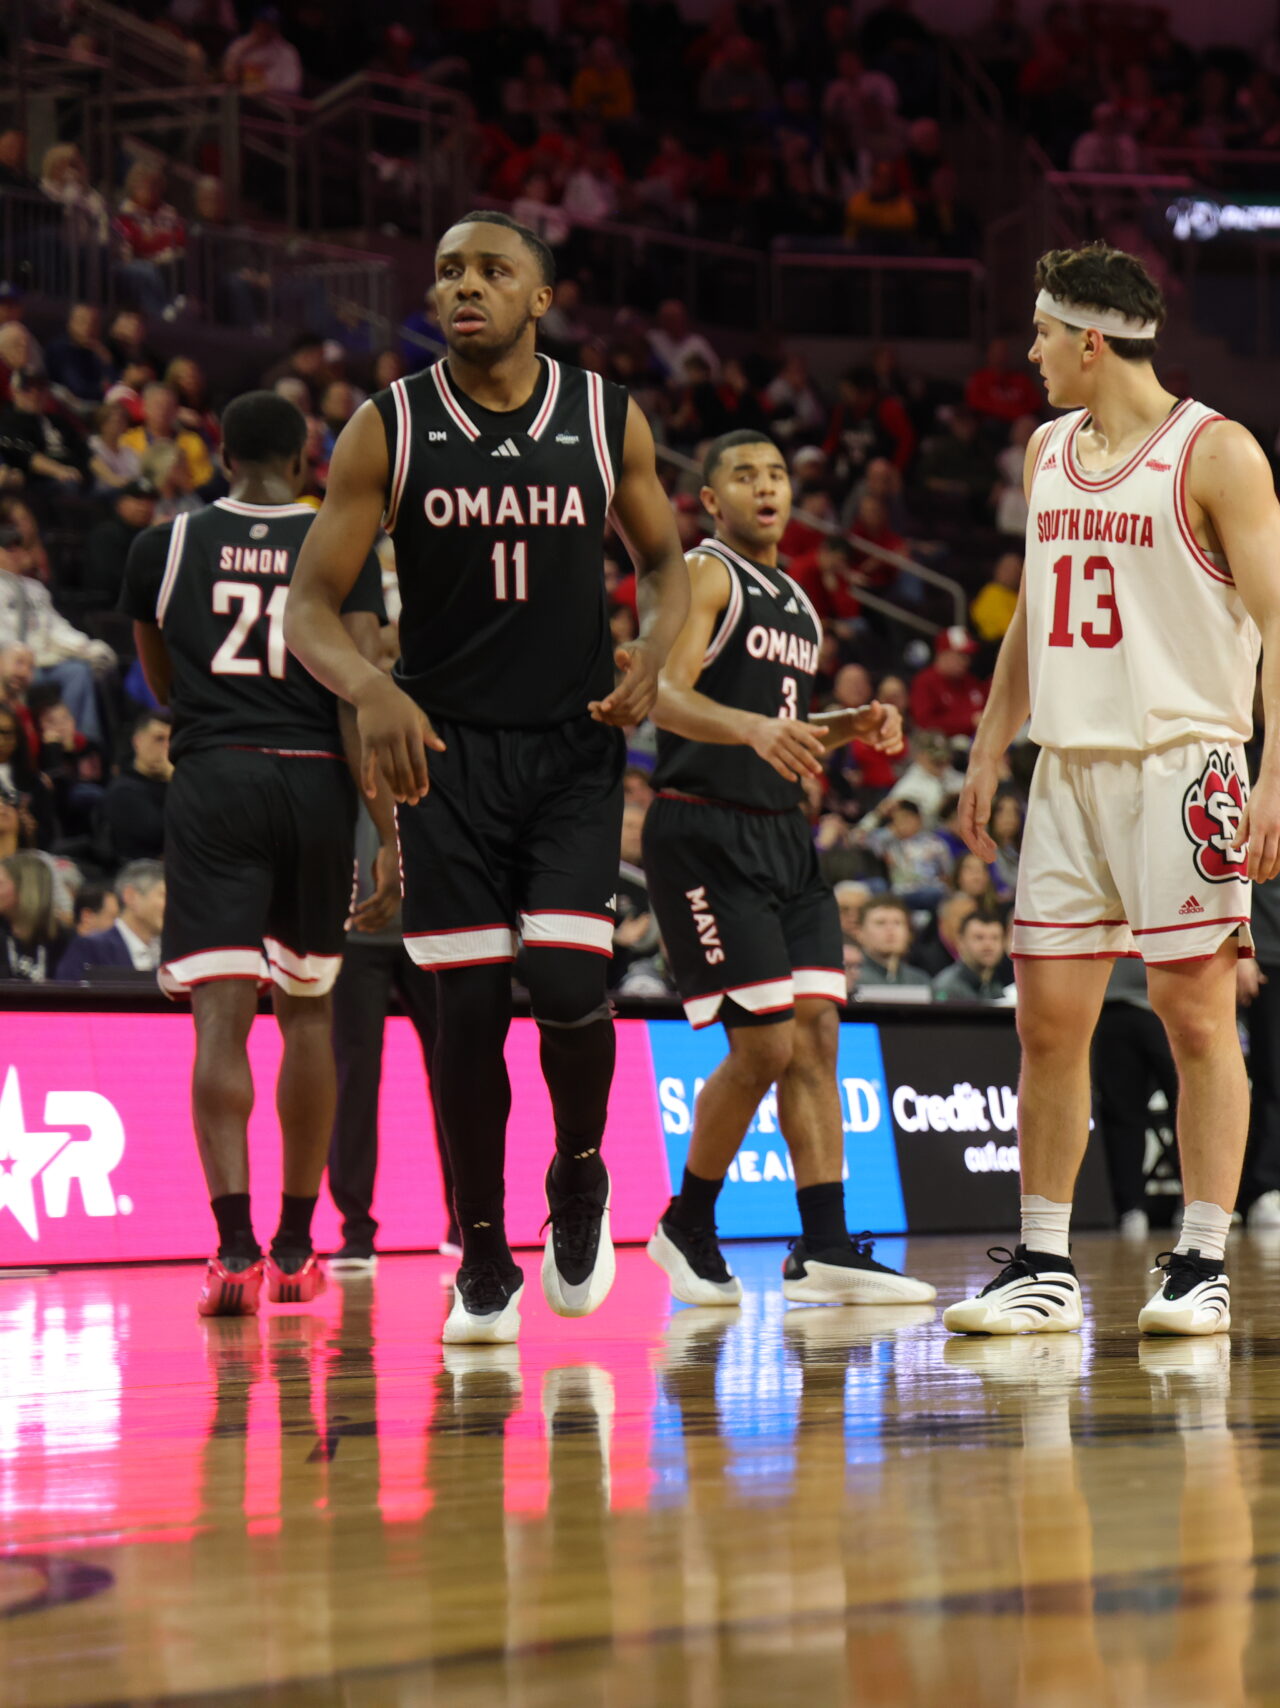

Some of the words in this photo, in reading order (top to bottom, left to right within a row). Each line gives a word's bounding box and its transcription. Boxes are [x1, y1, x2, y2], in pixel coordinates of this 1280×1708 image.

[428, 431, 447, 441] DM
[424, 486, 587, 527] OMAHA
[1037, 508, 1081, 543] SOUTH
[1083, 508, 1153, 548] DAKOTA
[219, 545, 289, 574] SIMON
[491, 541, 528, 601] 11
[1048, 555, 1123, 648] 13
[210, 580, 290, 679] 21
[778, 676, 798, 720] 3
[685, 886, 725, 965] MAVS
[893, 1082, 990, 1132] Credit
